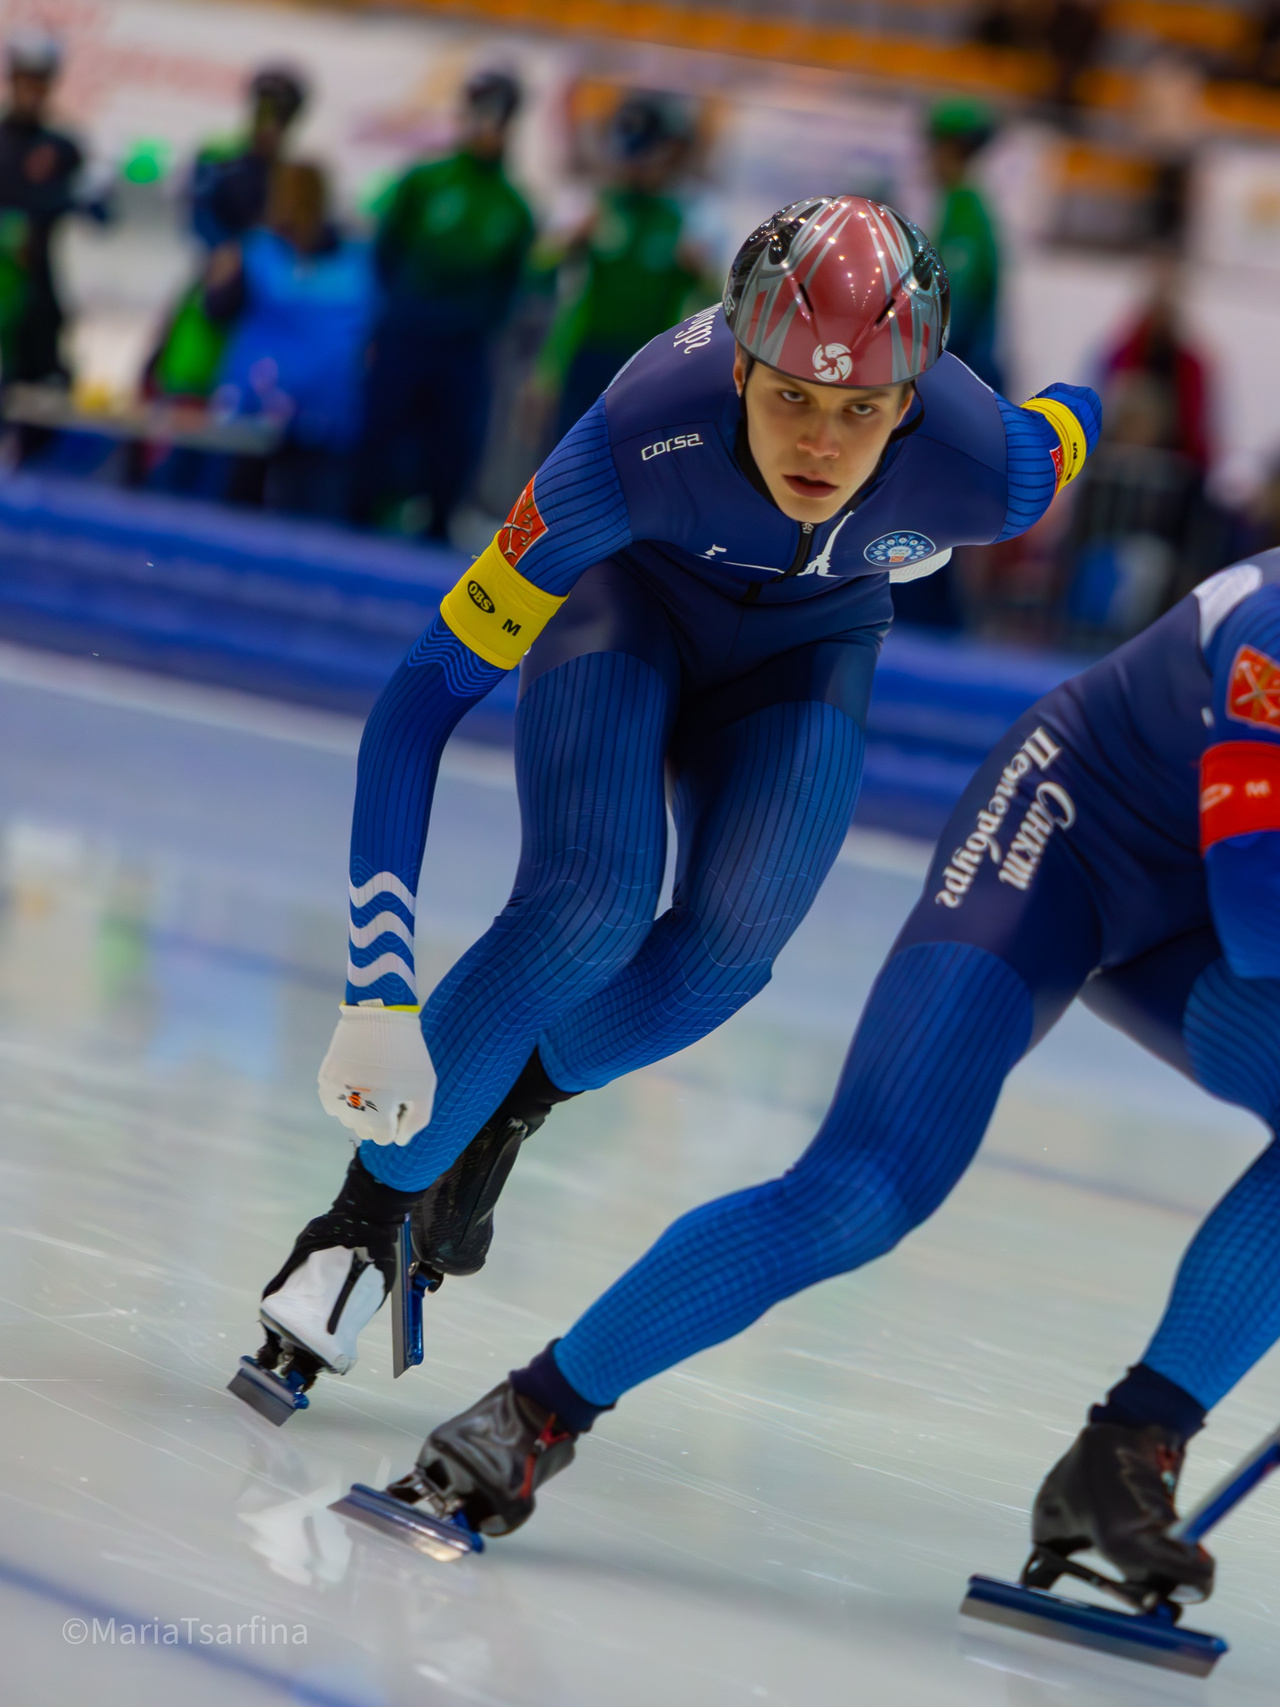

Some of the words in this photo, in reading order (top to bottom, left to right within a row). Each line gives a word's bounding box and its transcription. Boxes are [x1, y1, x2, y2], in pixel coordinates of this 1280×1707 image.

[641, 433, 703, 461] corsa
[468, 581, 493, 612] OBS
[501, 618, 522, 637] M
[934, 726, 1061, 909] Петербург
